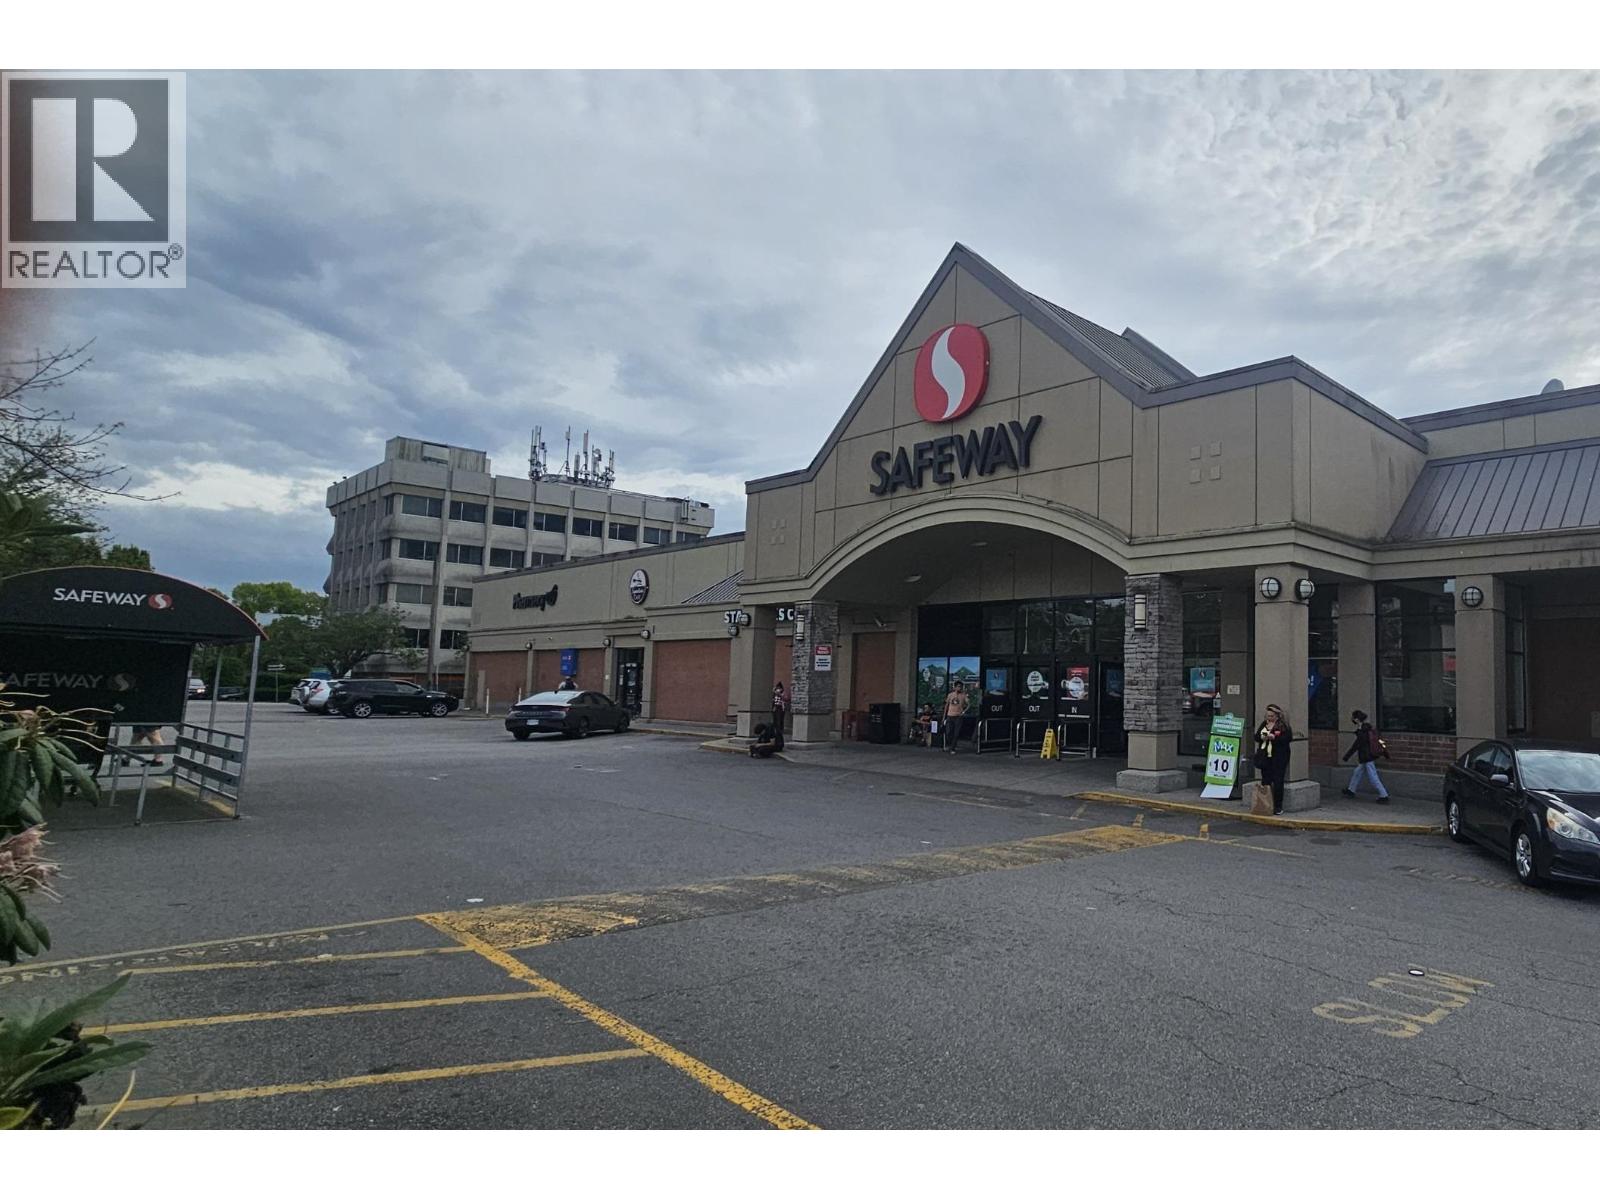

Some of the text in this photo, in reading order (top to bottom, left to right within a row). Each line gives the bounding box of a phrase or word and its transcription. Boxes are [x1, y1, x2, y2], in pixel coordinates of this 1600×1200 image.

[870, 414, 1043, 496] SAFEWAY
[53, 587, 147, 607] SAFEWAY
[0, 671, 103, 689] AFEWAY
[991, 704, 1004, 712] OUT
[1028, 704, 1041, 712] OUT
[1213, 758, 1229, 773] 10
